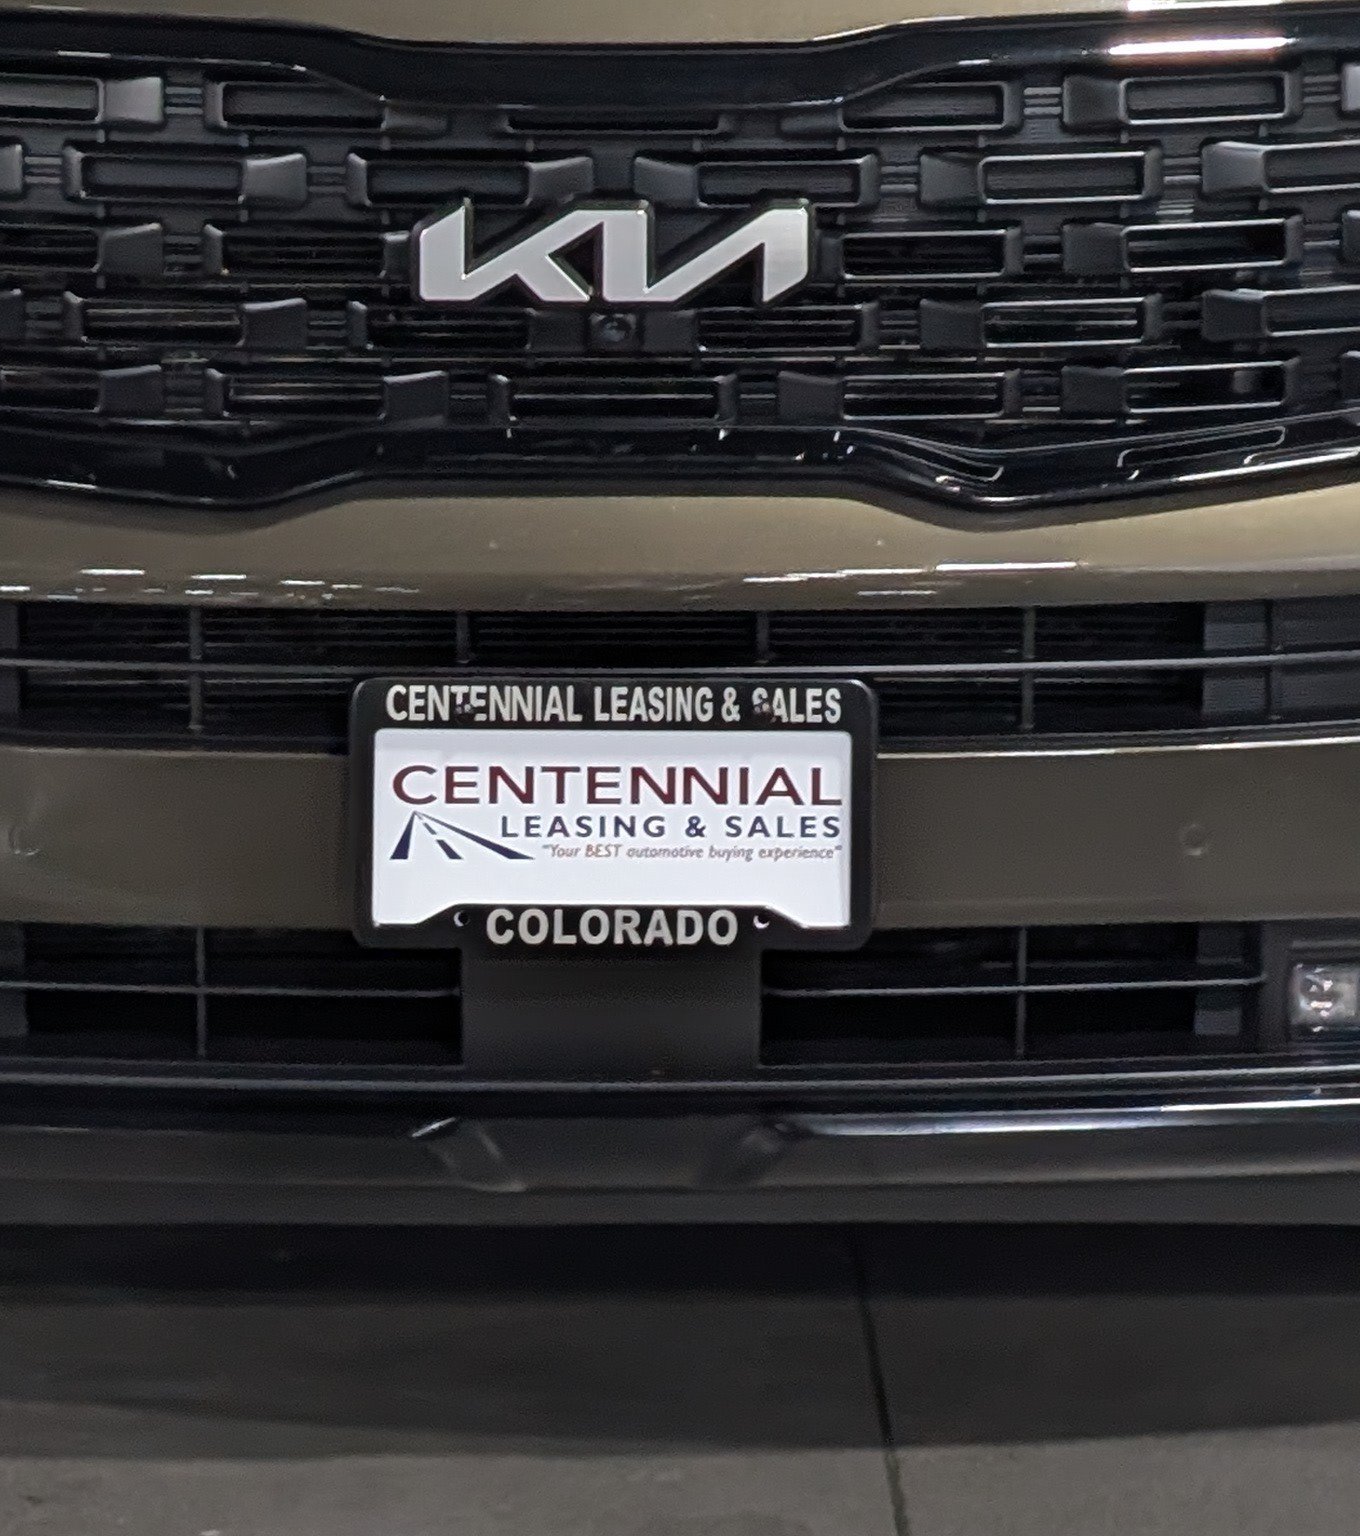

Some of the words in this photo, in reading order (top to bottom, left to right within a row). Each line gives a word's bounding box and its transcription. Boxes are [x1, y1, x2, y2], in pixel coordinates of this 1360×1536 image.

[593, 686, 713, 722] LEASING
[721, 687, 740, 722] &
[392, 765, 843, 806] CENTENNIAL
[501, 815, 666, 838] LEASING
[685, 815, 706, 838] &
[725, 815, 841, 839] SALES
[585, 843, 622, 858] BEST
[626, 844, 704, 859] automotive
[708, 845, 754, 863] buying
[486, 908, 738, 945] COLORADO
